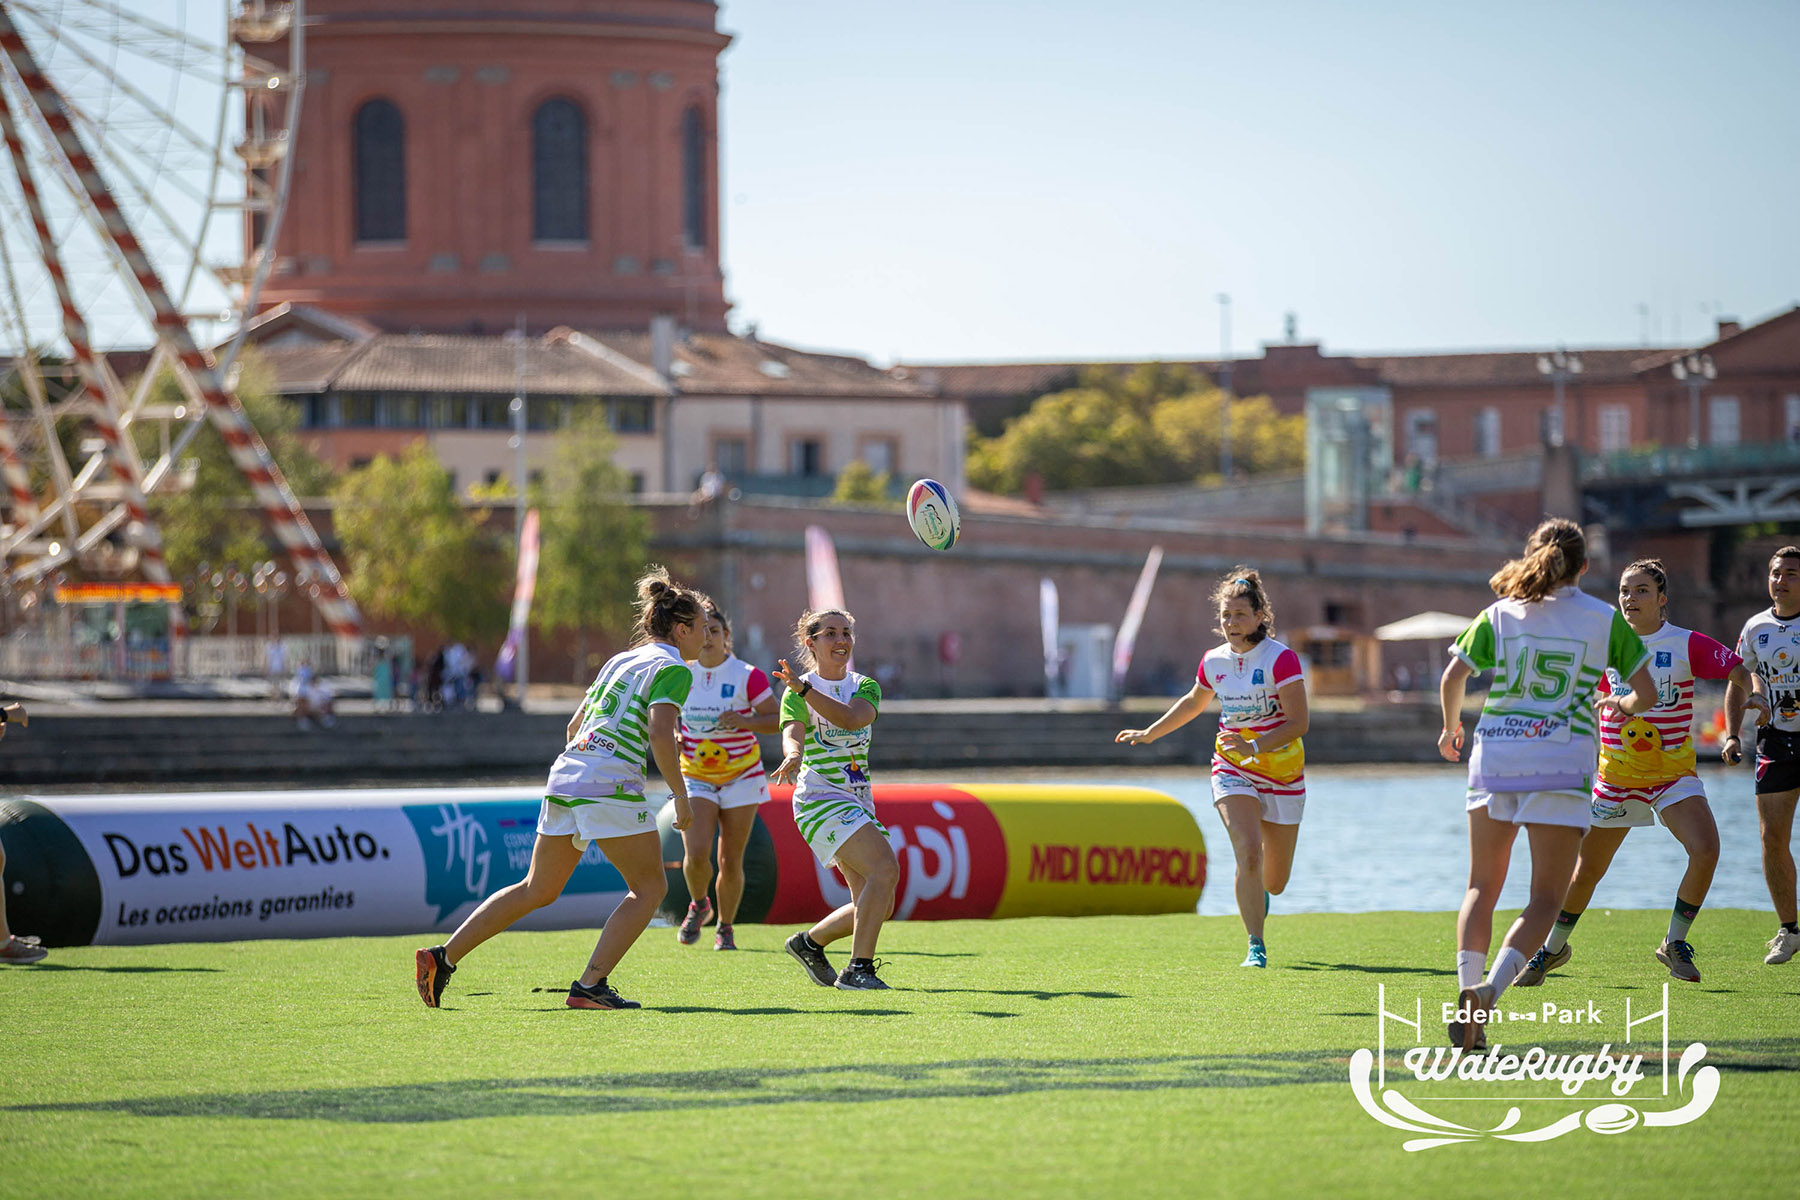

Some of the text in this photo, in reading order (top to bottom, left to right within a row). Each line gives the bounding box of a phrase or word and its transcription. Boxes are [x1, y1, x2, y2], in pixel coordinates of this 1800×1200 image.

[1506, 646, 1576, 702] 15
[1028, 844, 1081, 884] MIDI
[117, 886, 355, 928] Les occasions garanties
